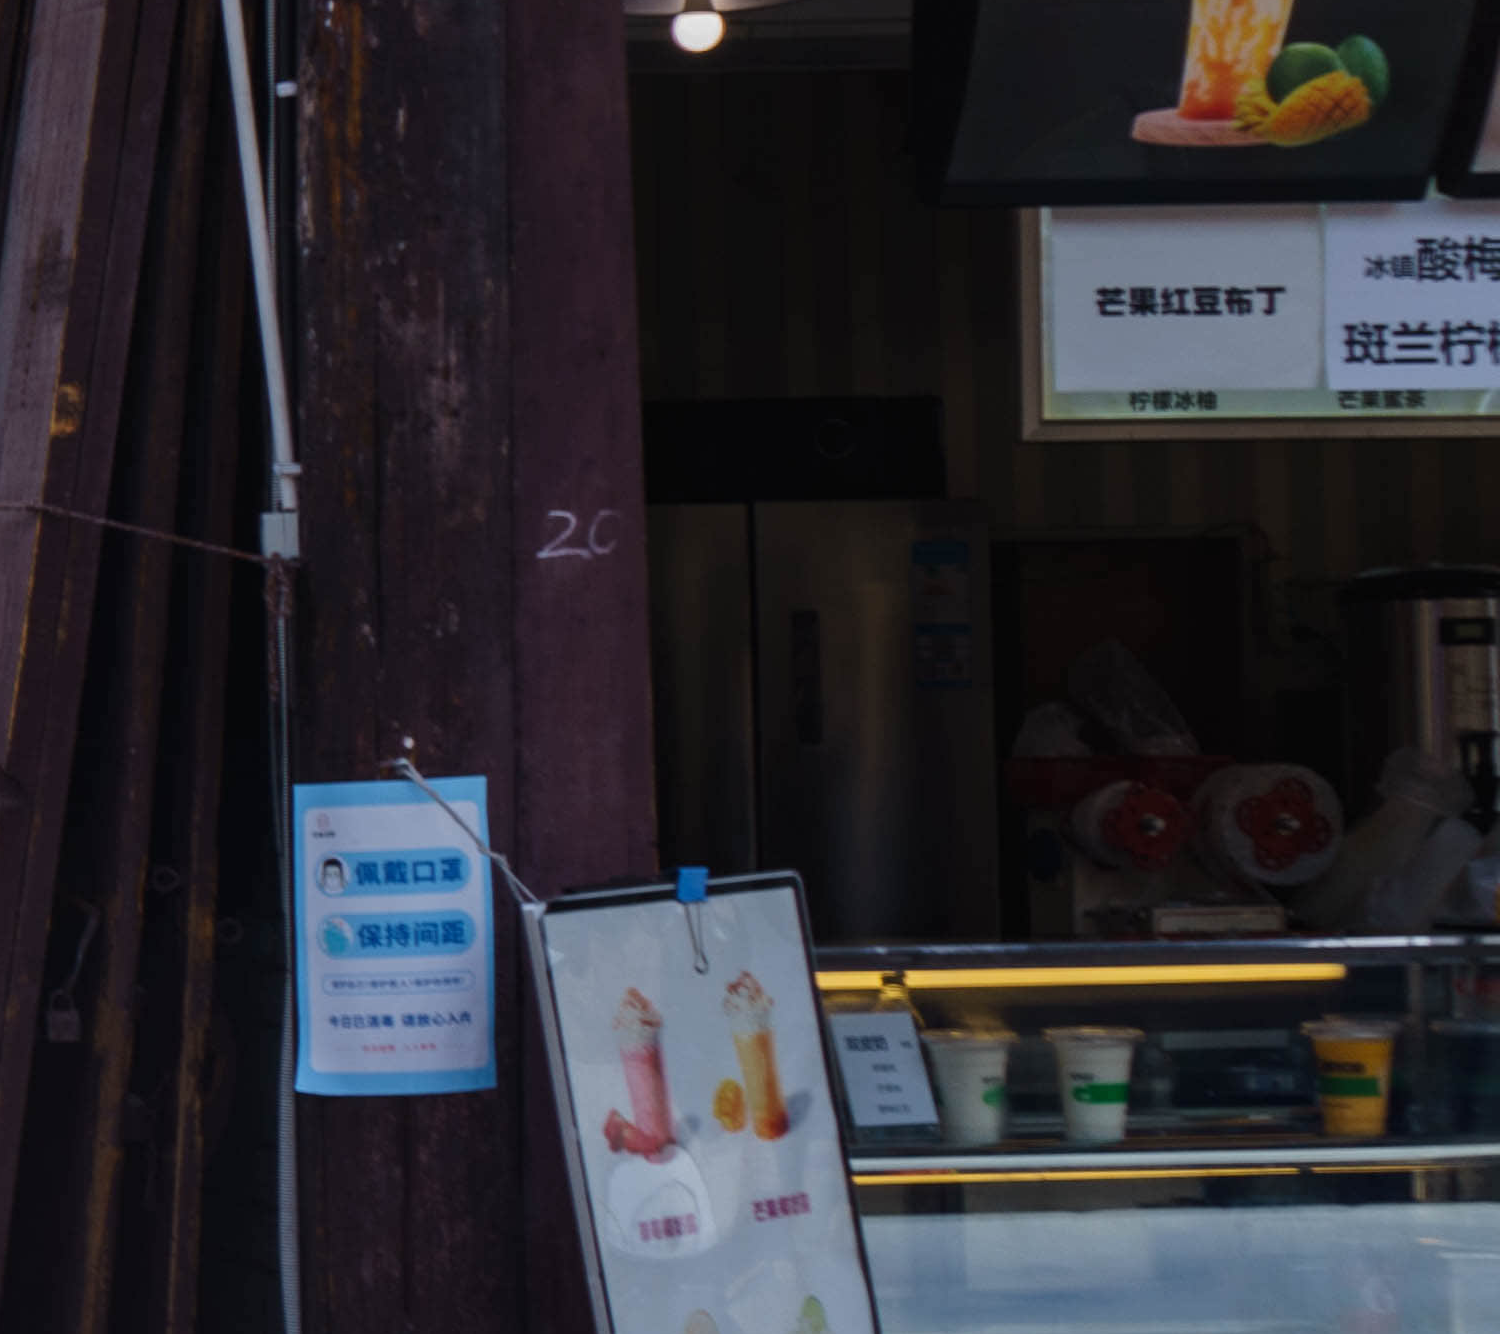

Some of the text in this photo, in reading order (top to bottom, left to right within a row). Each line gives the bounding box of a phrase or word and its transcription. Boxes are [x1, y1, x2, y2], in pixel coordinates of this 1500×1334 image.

[1096, 287, 1286, 317] 芒果红豆布丁
[355, 857, 463, 886] 佩戴口罩
[357, 919, 466, 949] 保持间距
